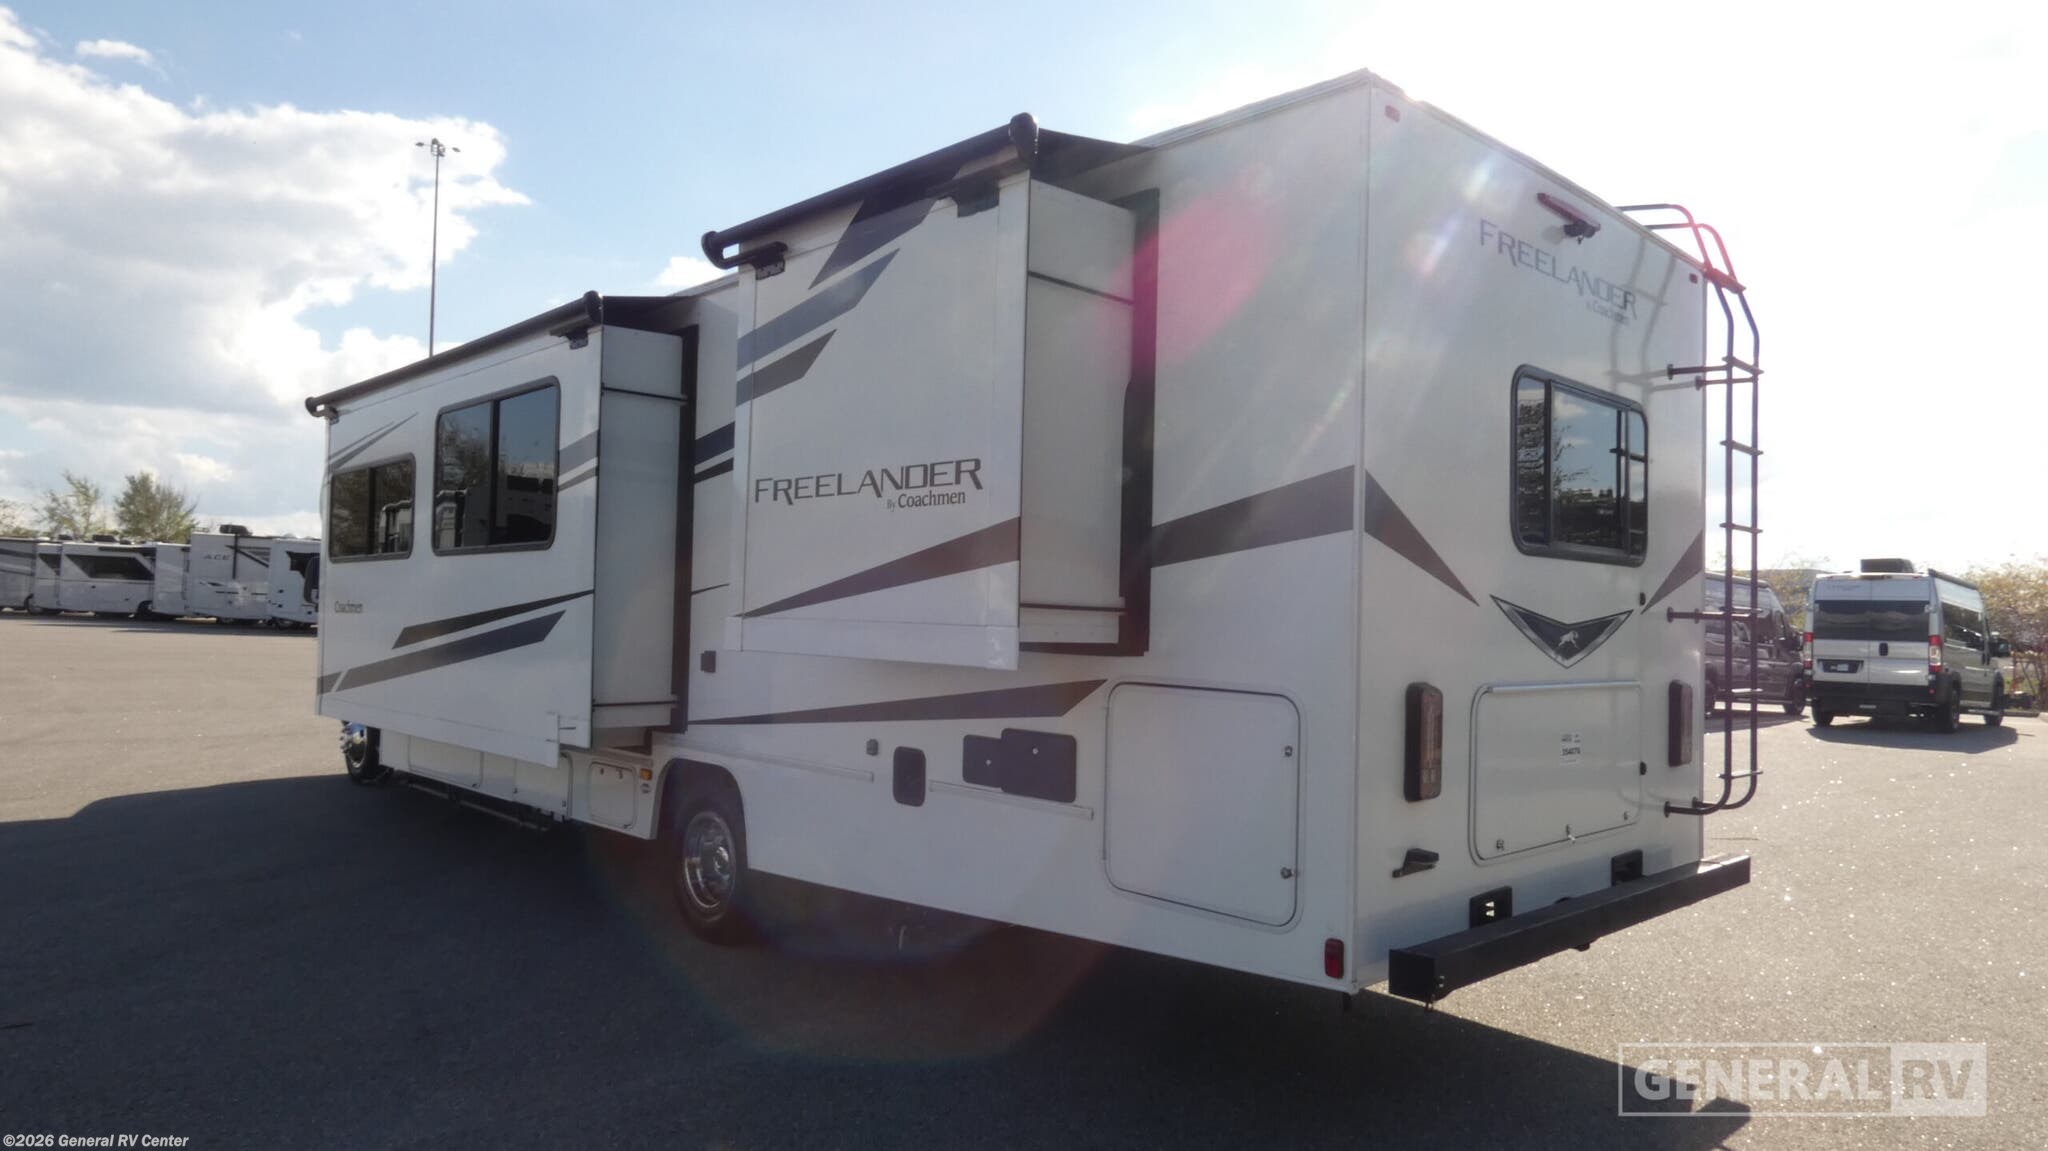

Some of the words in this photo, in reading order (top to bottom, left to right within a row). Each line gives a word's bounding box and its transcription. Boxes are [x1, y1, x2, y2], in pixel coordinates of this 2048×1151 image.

[1479, 218, 1638, 321] FREELANDER
[754, 457, 984, 506] FREELANDER
[897, 489, 966, 509] Coachmen
